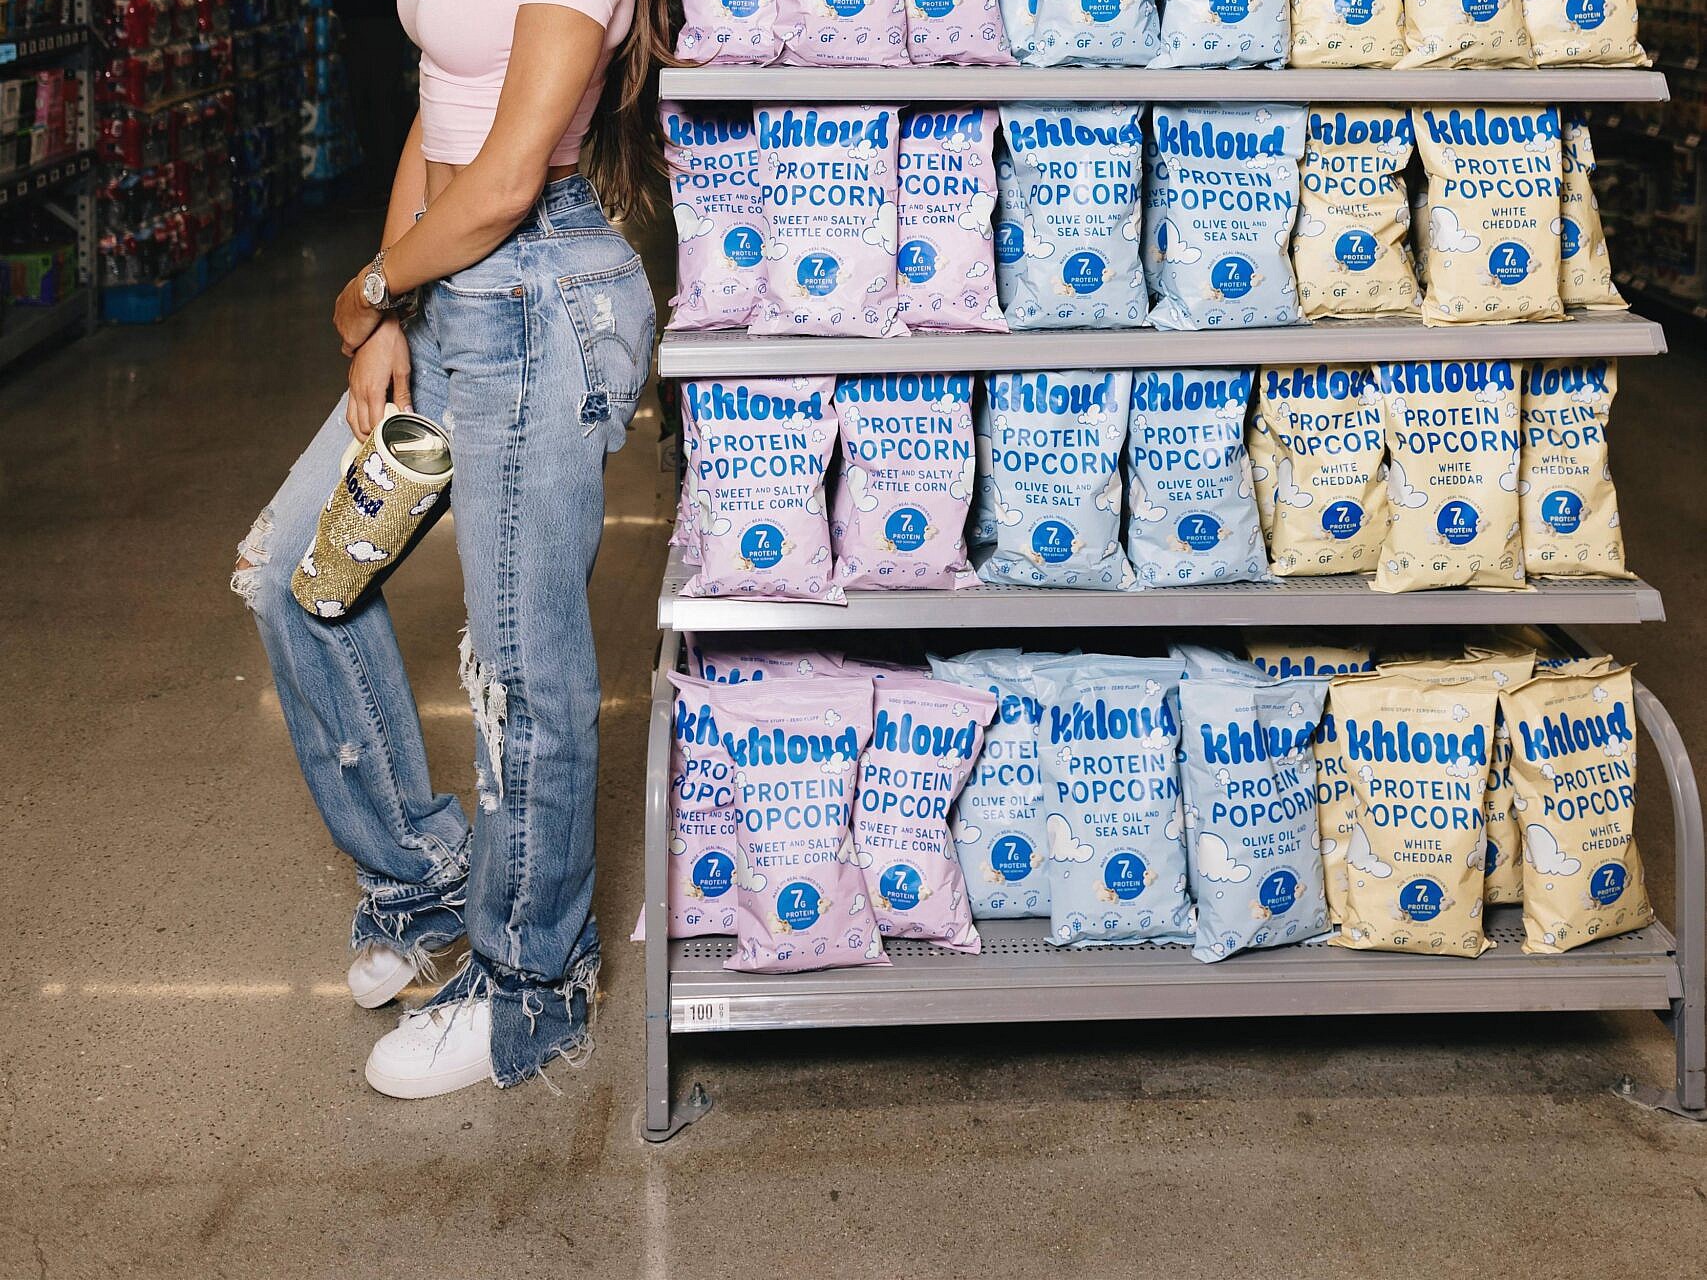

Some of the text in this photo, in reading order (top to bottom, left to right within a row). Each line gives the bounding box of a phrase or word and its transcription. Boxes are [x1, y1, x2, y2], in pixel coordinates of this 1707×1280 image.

[1077, 39, 1091, 48] GF
[1566, 48, 1580, 56] GF
[759, 110, 889, 150] khloud
[1424, 107, 1561, 145] khloud
[1158, 116, 1284, 160] khloud
[776, 162, 868, 181] PROTEIN
[1455, 156, 1550, 175] PROTEIN
[1180, 168, 1271, 187] PROTEIN
[762, 185, 884, 206] POPCORN
[1168, 188, 1291, 212] POPCORN
[1491, 208, 1527, 217] WHITE
[773, 215, 809, 226] SWEET
[831, 215, 866, 225] SALTY
[1193, 220, 1227, 229] OLIVE
[1231, 220, 1250, 229] OIL
[1482, 219, 1536, 229] CHEDDAR
[778, 228, 859, 237] KETTLE CORN
[1204, 231, 1258, 241] SEA SALT
[795, 315, 808, 323] GF
[990, 373, 1118, 414] khloud
[688, 383, 822, 421] khloud
[1405, 407, 1499, 426] PROTEIN
[710, 435, 806, 454] PROTEIN
[1003, 429, 1099, 447] PROTEIN
[1396, 430, 1519, 455] POPCORN
[700, 454, 823, 480] POPCORN
[1439, 463, 1471, 472] WHITE
[1429, 474, 1483, 485] CHEDDAR
[715, 487, 751, 498] SWEET
[774, 485, 809, 496] SALTY
[1015, 482, 1049, 492] OLIVE
[1054, 484, 1073, 493] OIL
[721, 498, 803, 511] KETTLE CORN
[1025, 494, 1080, 506] SEA SALT
[1051, 697, 1177, 744] khloud
[1519, 702, 1632, 761] khloud
[1347, 720, 1486, 765] khloud
[1069, 755, 1165, 775] PROTEIN
[1058, 775, 1180, 804] POPCORN
[1370, 779, 1470, 801] PROTEIN
[1085, 813, 1118, 824] OLIVE
[1123, 812, 1142, 823] OIL
[1095, 825, 1150, 837] SEA SALT
[1590, 824, 1621, 837] WHITE
[749, 841, 786, 853] SWEET
[808, 838, 842, 848] SALTY
[1404, 840, 1442, 850] WHITE
[1582, 835, 1632, 852] CHEDDAR
[756, 852, 837, 867] KETTLE CORN
[1394, 851, 1452, 864] CHEDDAR
[1394, 936, 1408, 946] GF
[690, 1004, 712, 1020] 100
